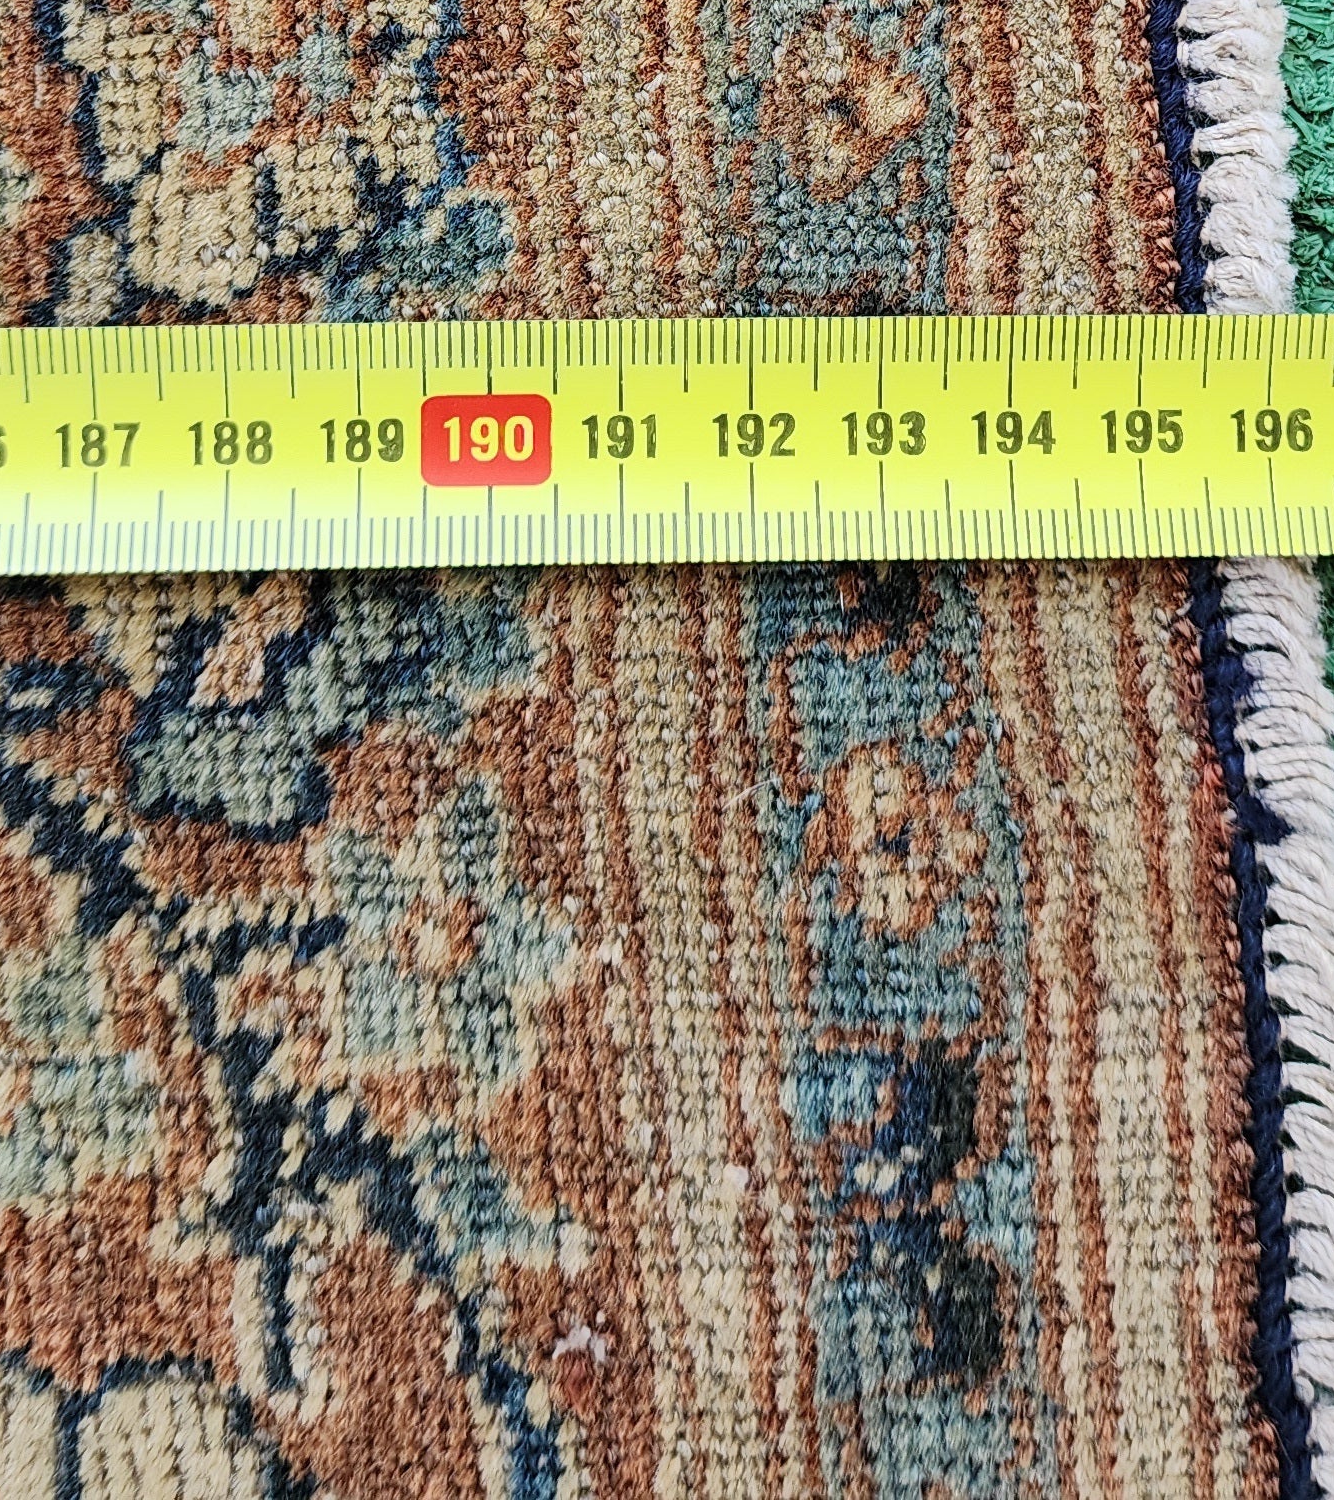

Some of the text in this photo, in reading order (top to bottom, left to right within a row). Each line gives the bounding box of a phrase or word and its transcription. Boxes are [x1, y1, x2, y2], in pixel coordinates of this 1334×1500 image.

[54, 422, 141, 469] 187
[187, 421, 273, 466] 188
[319, 419, 404, 464] 189
[442, 416, 534, 462] 190
[581, 415, 657, 459] 191
[712, 413, 796, 458] 192
[841, 412, 927, 456] 193
[970, 411, 1056, 455] 194
[1100, 410, 1185, 454] 195
[1230, 409, 1314, 453] 196
